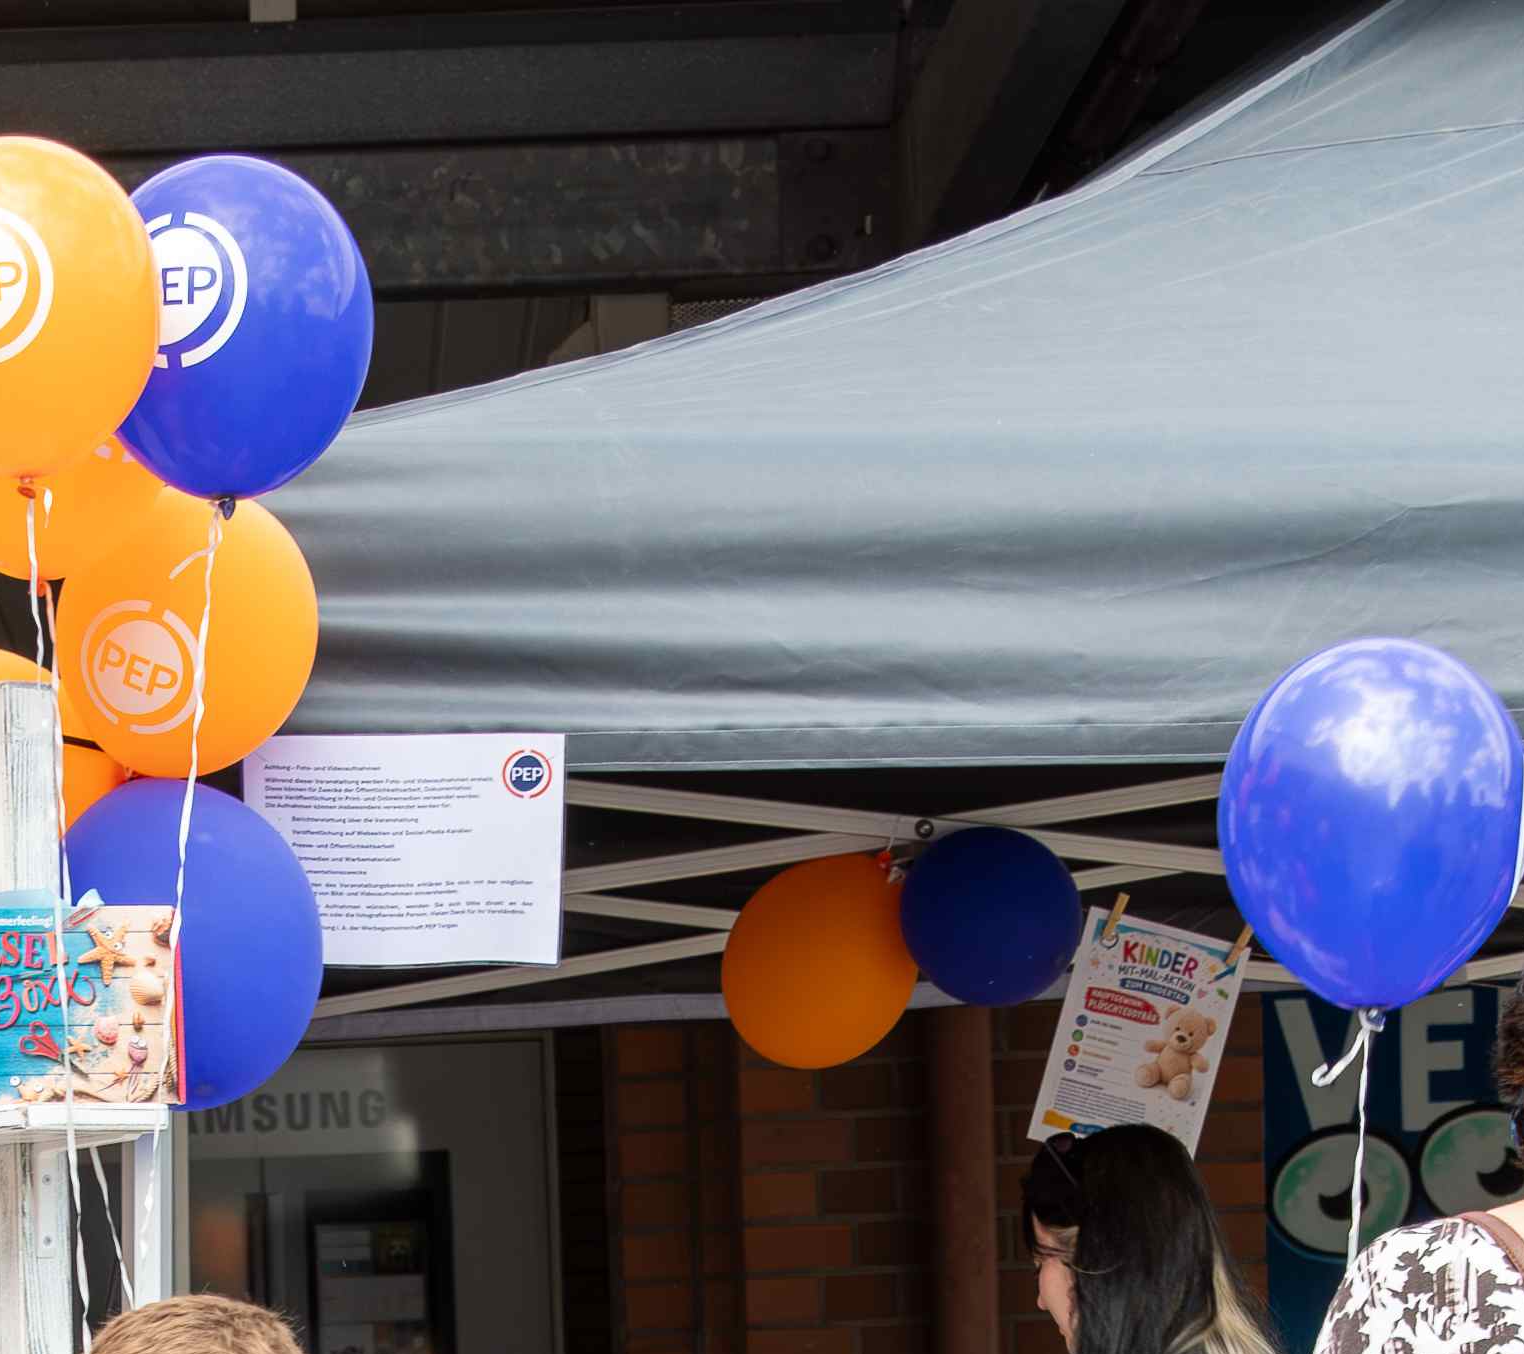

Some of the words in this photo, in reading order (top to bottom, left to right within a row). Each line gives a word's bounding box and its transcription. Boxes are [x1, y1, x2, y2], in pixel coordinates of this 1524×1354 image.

[159, 265, 217, 308] EP
[99, 640, 178, 697] PEP
[511, 766, 544, 782] PEP
[1122, 939, 1200, 981] KINDER
[188, 1090, 387, 1135] MSUNG
